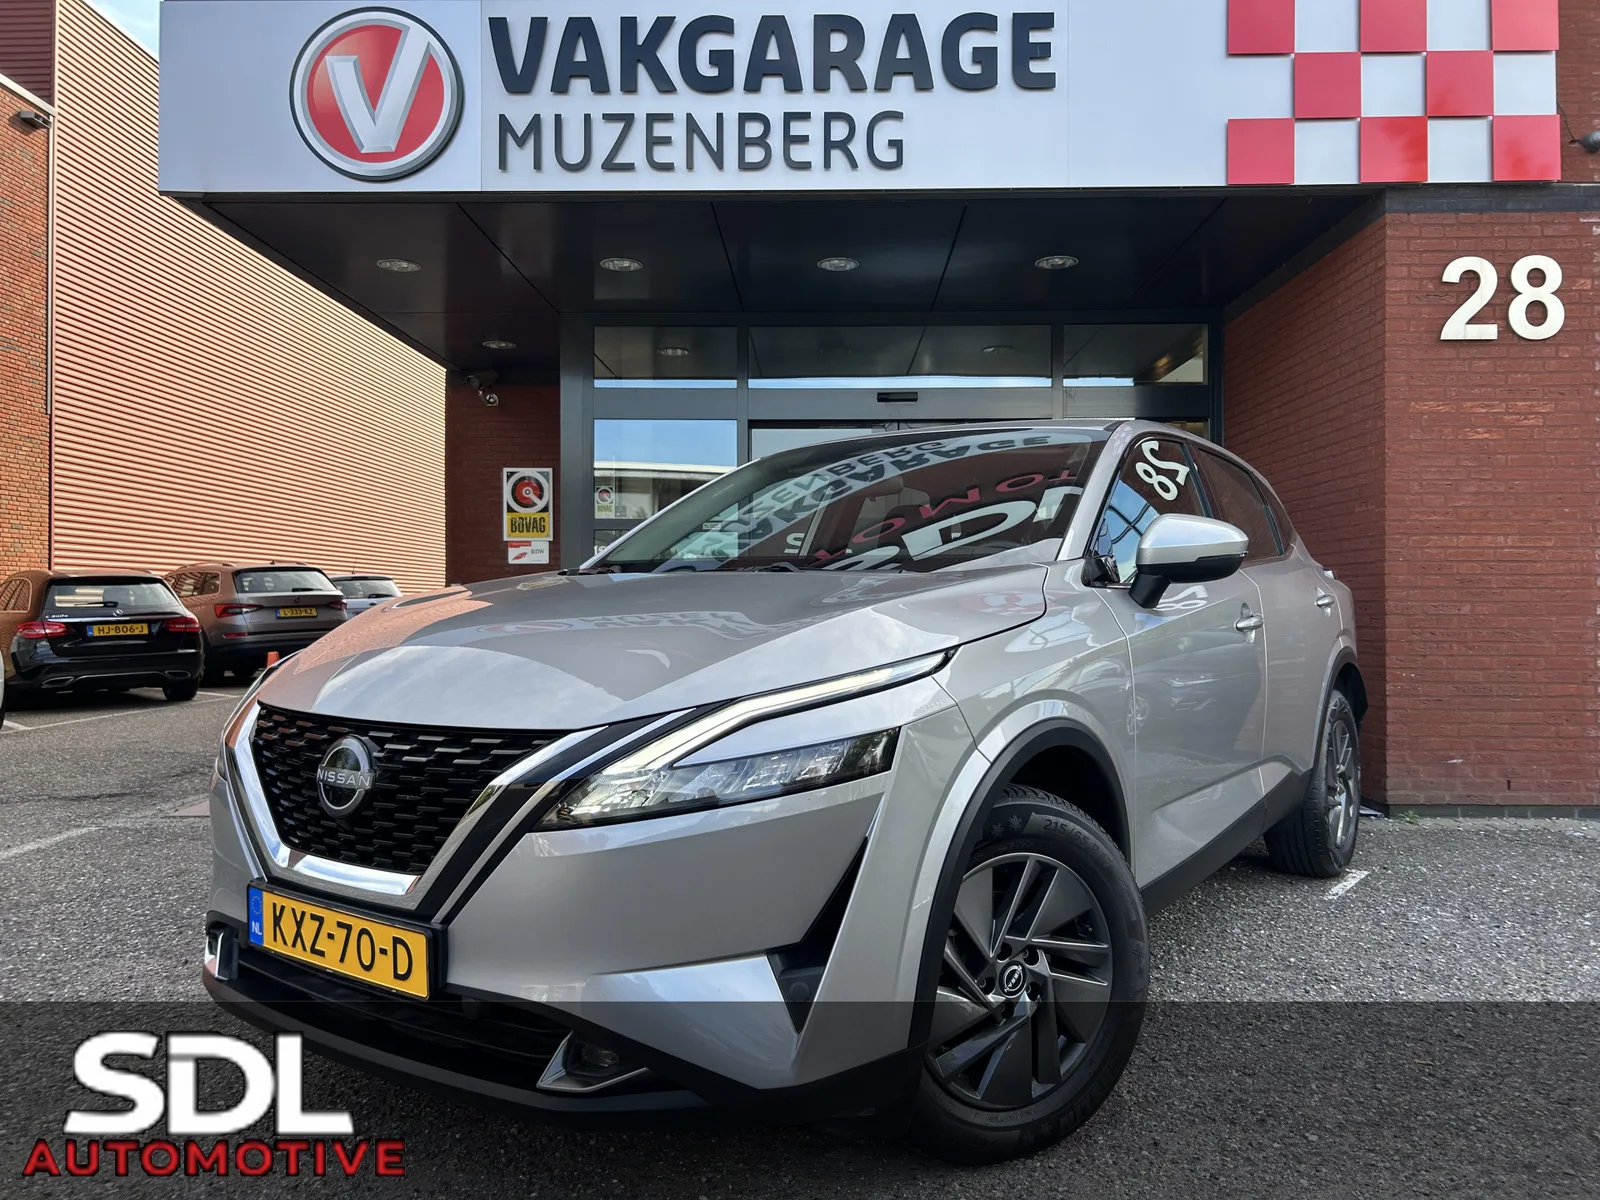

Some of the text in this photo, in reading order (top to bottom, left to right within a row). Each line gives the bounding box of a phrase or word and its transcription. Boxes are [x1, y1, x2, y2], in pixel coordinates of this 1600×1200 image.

[488, 12, 1057, 94] VAKGARAGE
[498, 110, 905, 172] MUZENBERG
[1440, 255, 1565, 341] 28
[510, 516, 546, 533] BOVAG
[97, 624, 144, 635] HJ-806-J
[317, 769, 371, 788] NISSAN
[251, 920, 263, 936] NL
[272, 902, 413, 981] KXZ-70-D
